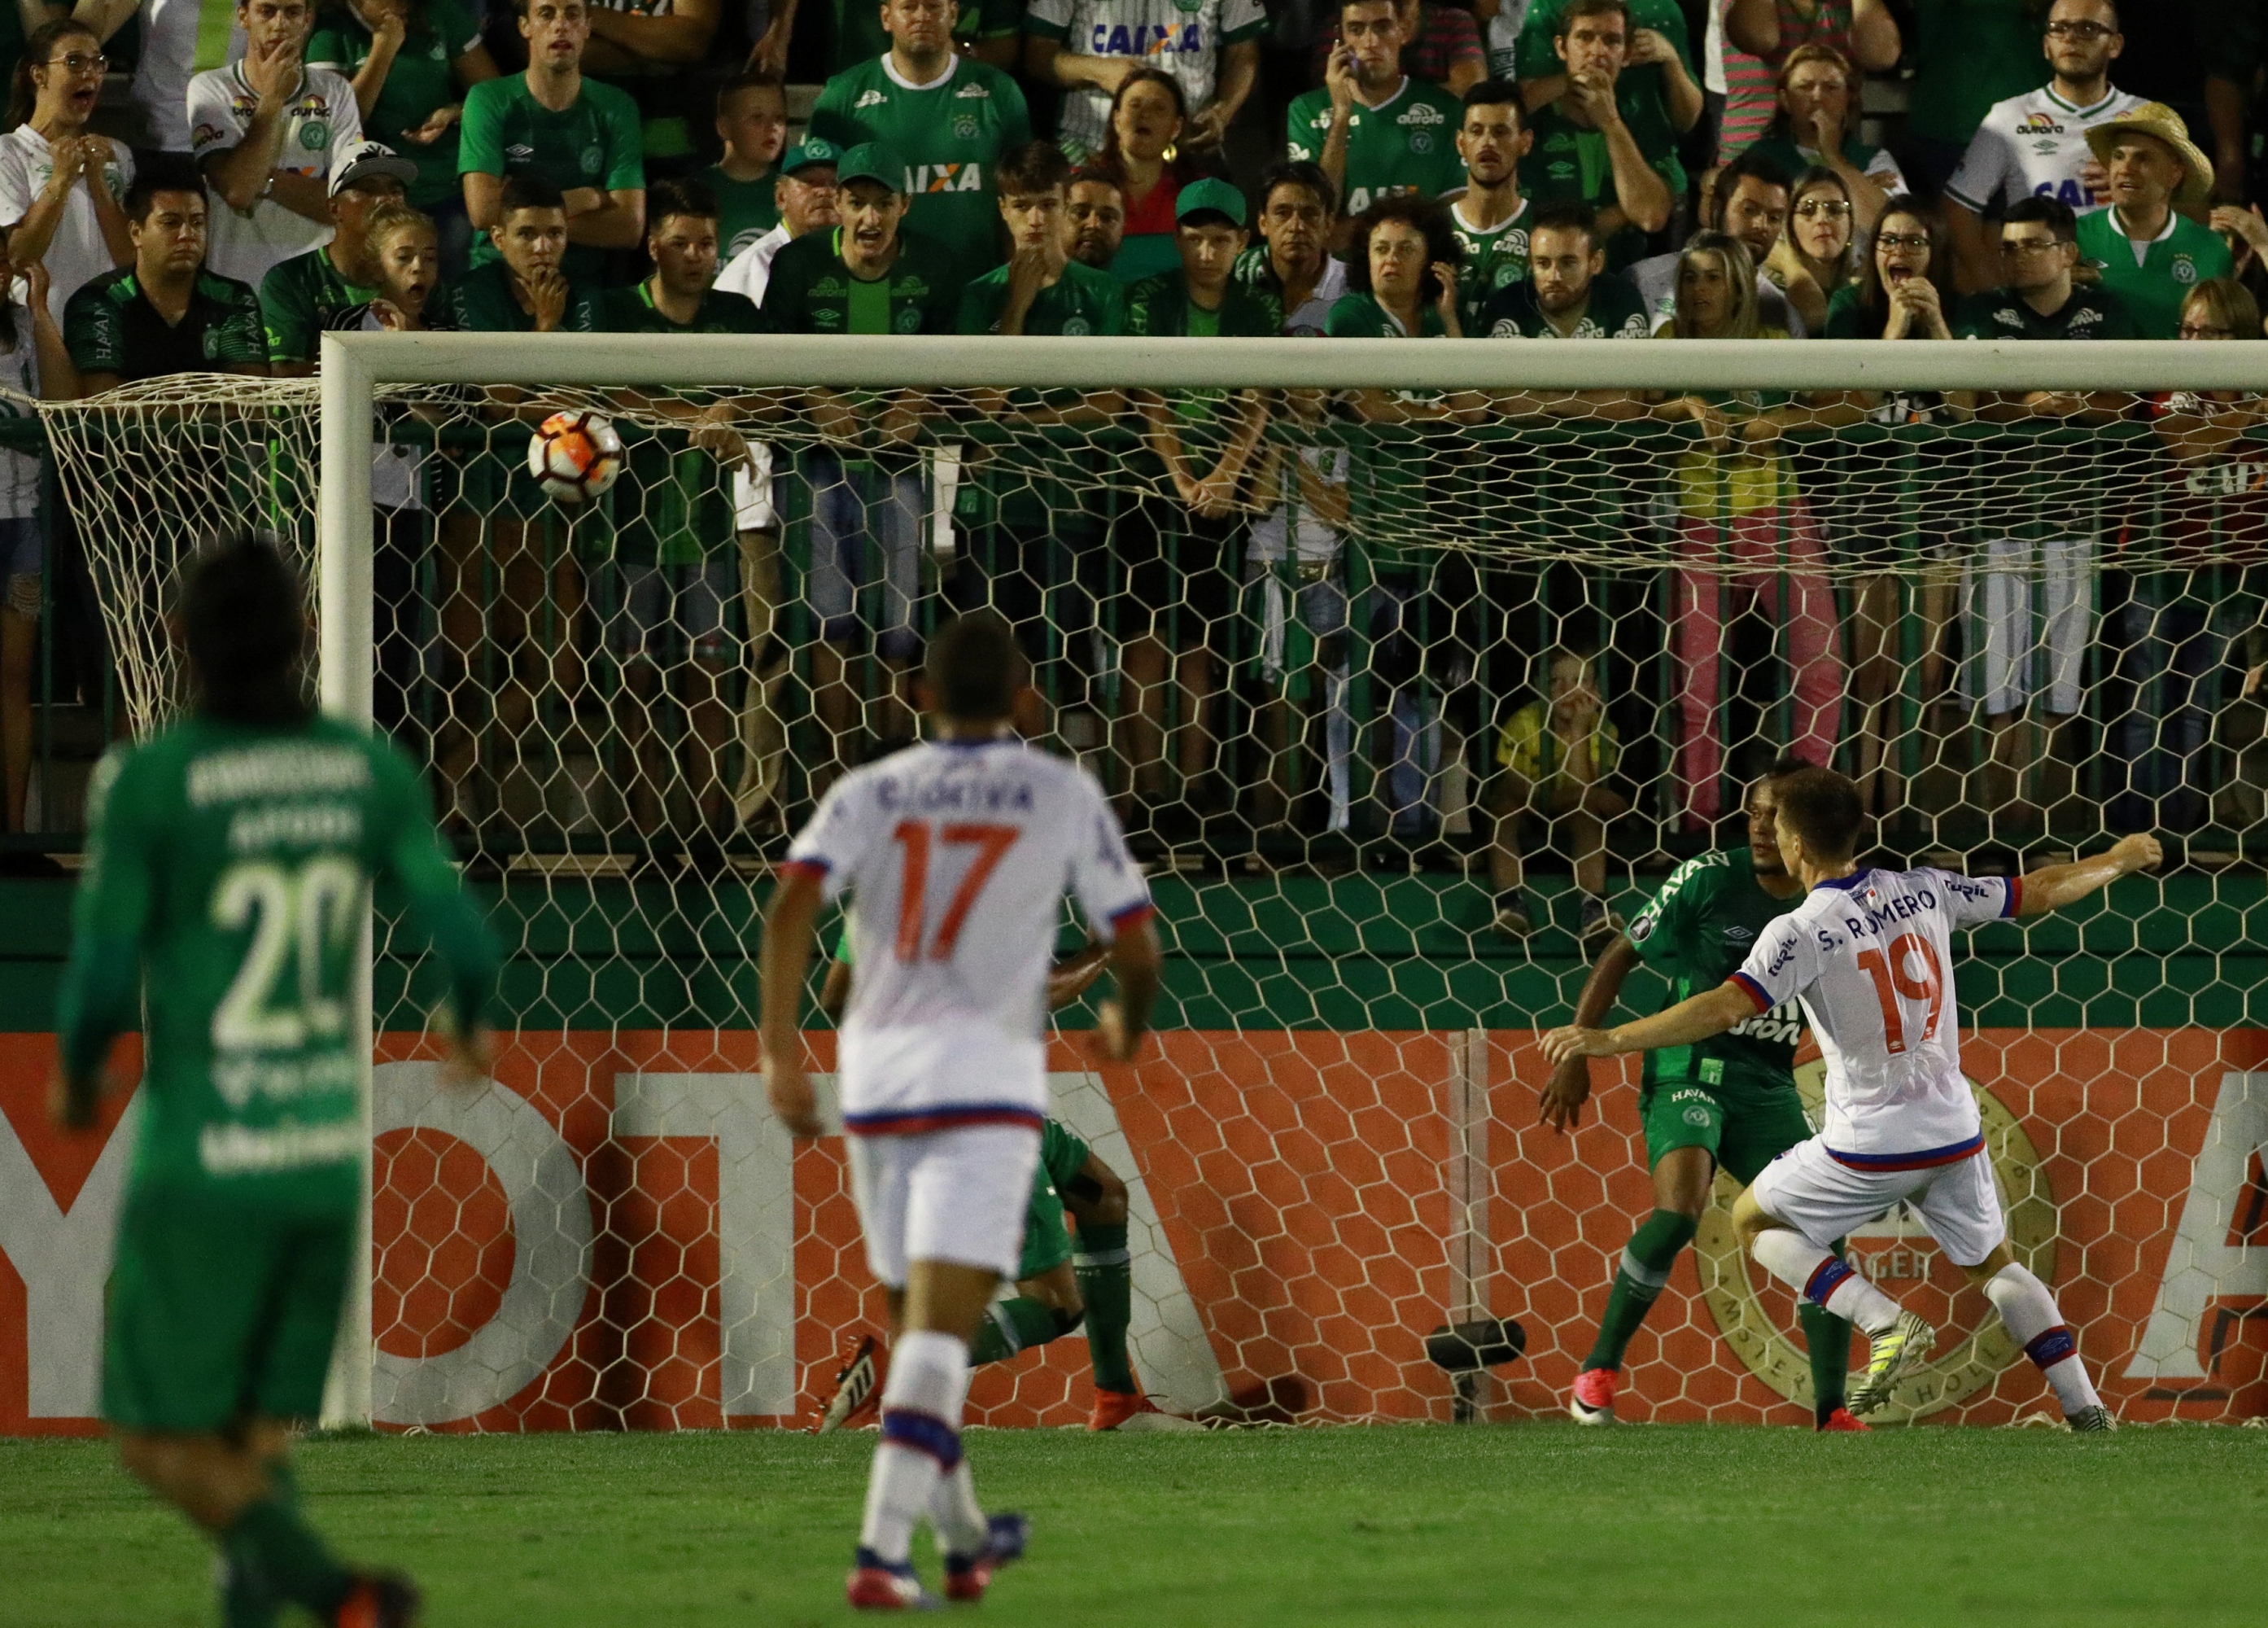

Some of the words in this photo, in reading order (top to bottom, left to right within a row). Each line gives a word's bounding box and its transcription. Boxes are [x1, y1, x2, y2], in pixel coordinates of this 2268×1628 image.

[1093, 23, 1200, 55] CAIXA
[1396, 112, 1446, 125] aurora
[2016, 124, 2065, 134] aurora
[94, 301, 113, 361] HAVAN
[244, 293, 263, 356] HAVAN
[893, 817, 1021, 964] 17
[1644, 851, 1732, 929] HAVAN
[1818, 930, 1843, 952] S.
[1846, 890, 1936, 939] ROMERO
[210, 856, 363, 1050] 20
[1856, 932, 1943, 1054] 19
